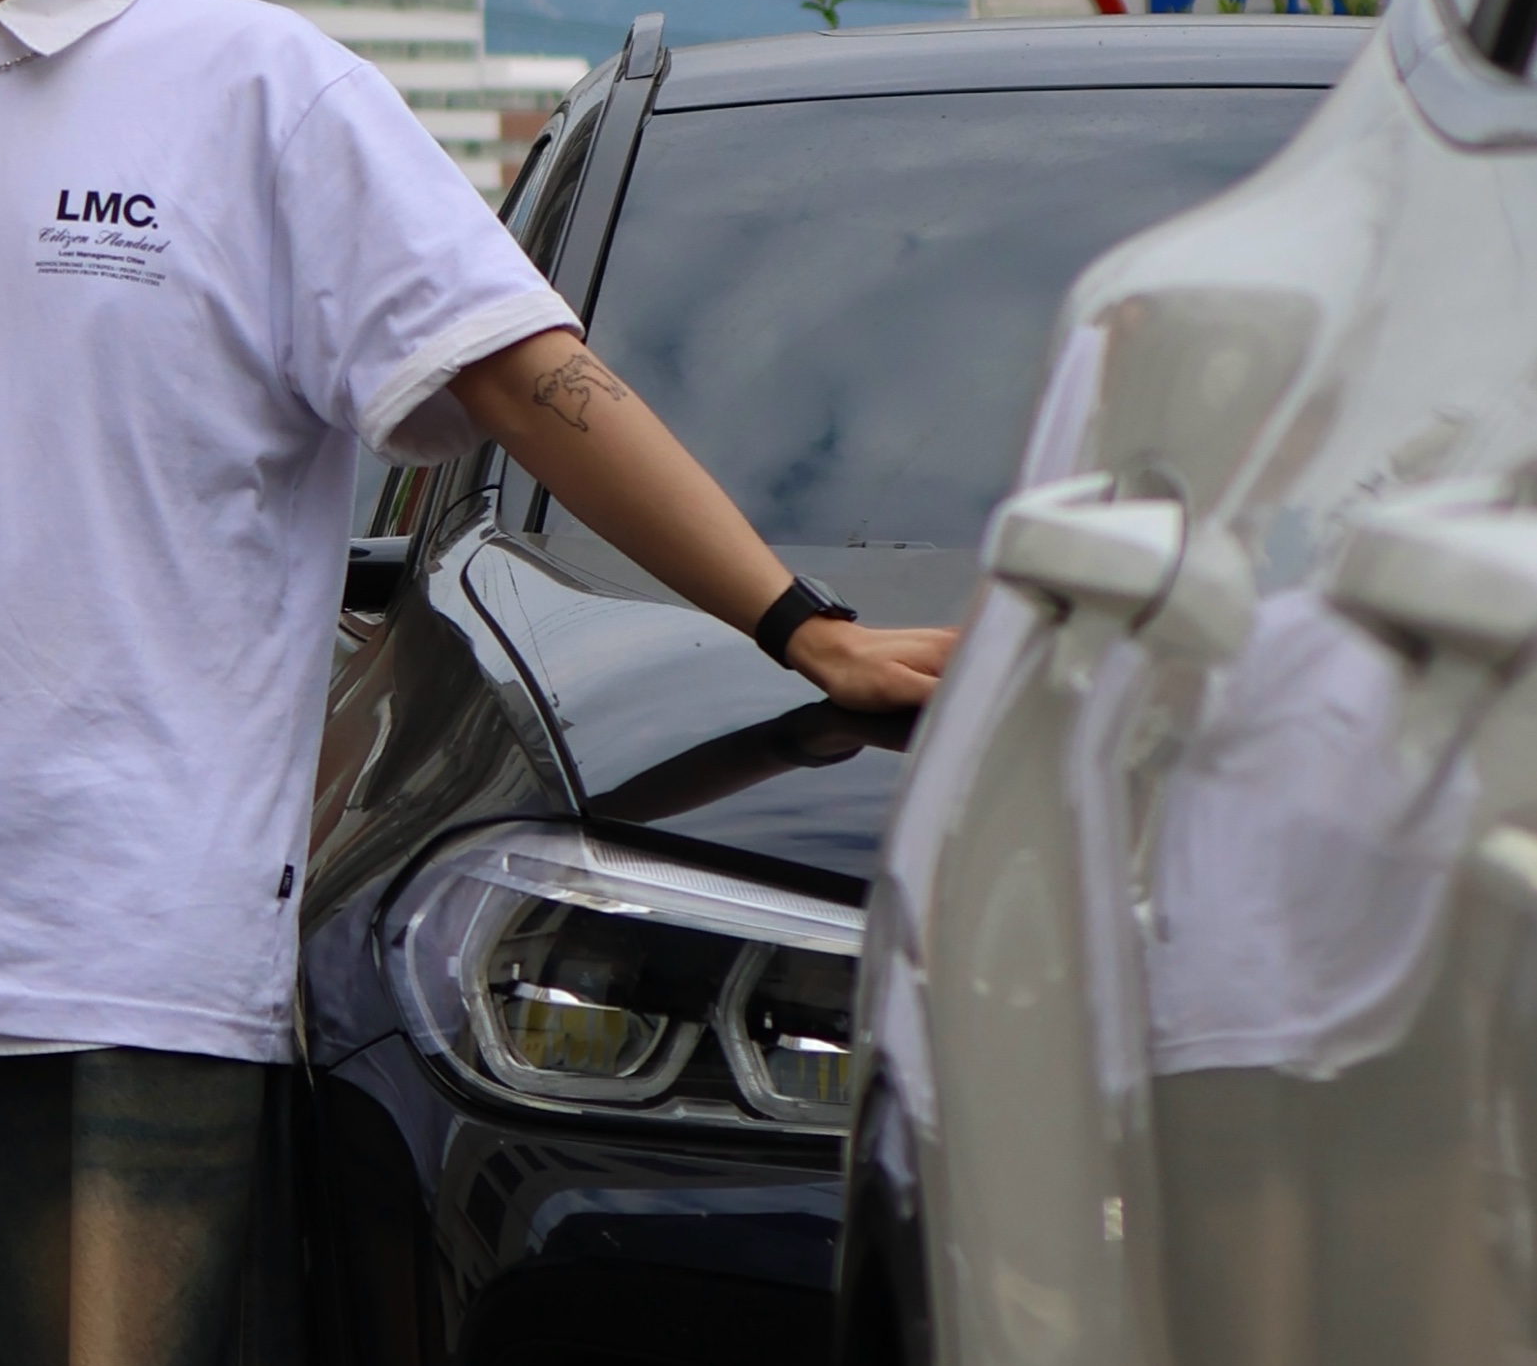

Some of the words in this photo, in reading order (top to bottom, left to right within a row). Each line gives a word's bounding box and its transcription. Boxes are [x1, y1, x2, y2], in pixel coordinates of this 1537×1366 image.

[56, 189, 159, 230] LMC.
[94, 230, 171, 254] Standard
[76, 251, 124, 262] Management
